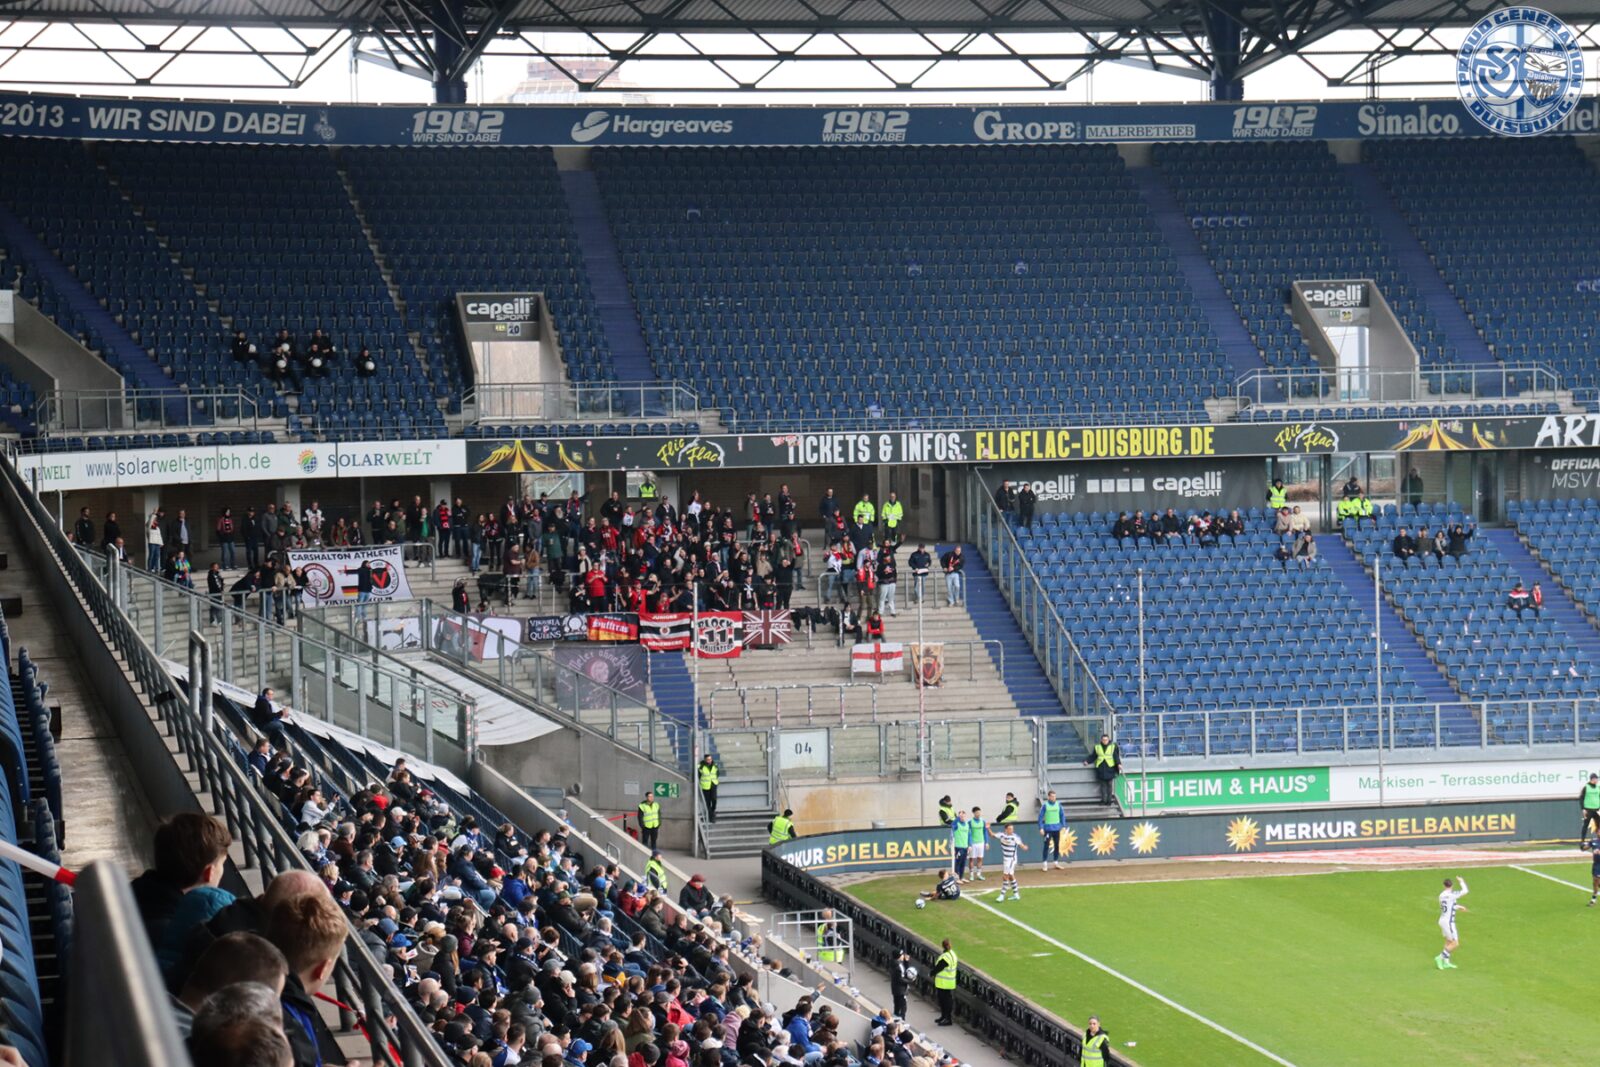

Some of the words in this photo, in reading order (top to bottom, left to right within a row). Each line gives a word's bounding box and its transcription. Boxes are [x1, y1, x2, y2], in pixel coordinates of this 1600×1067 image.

[2, 103, 64, 127] 2013
[88, 107, 140, 130] WIR
[147, 108, 215, 132] SIND
[222, 112, 306, 135] DABEI
[412, 111, 504, 133] 1902
[613, 115, 733, 138] Hargreaves
[822, 111, 909, 133] 1902
[1232, 106, 1318, 129] 1902
[1358, 105, 1459, 135] Sinalco
[412, 132, 434, 142] WIR
[436, 132, 463, 142] SIND
[466, 132, 500, 143] DABEI
[822, 132, 842, 142] WIR
[844, 132, 870, 142] SIND
[873, 132, 904, 142] DABEI
[1087, 125, 1195, 138] MALERBETRIEB
[1232, 128, 1252, 138] WIR
[1254, 127, 1278, 137] SIND
[1281, 127, 1313, 137] DABEI
[1303, 284, 1361, 305] capelli
[466, 298, 530, 318] capelli
[788, 435, 870, 464] TICKETS
[879, 435, 892, 462] &
[901, 432, 967, 462] INFOS:
[975, 426, 1215, 460] FLICFLAC-DUISBURG.DE
[86, 452, 271, 476] www.solarwelt-gmbh.de
[327, 452, 432, 468] SOLARWELT
[1152, 471, 1222, 495] capelli
[1552, 472, 1592, 489] MSV
[1037, 493, 1075, 501] SPORT
[1184, 489, 1221, 497] SPORT
[291, 553, 351, 561] CARSHALTON
[354, 548, 398, 559] ATHLETIC
[704, 629, 727, 643] 11
[795, 742, 812, 755] 04
[1170, 777, 1222, 797] HEIM
[1229, 778, 1243, 796] &
[1358, 777, 1424, 790] Markisen
[1441, 770, 1561, 787] Terrassendächer
[1265, 821, 1356, 840] MERKUR
[1360, 814, 1515, 837] SPIELBANKEN
